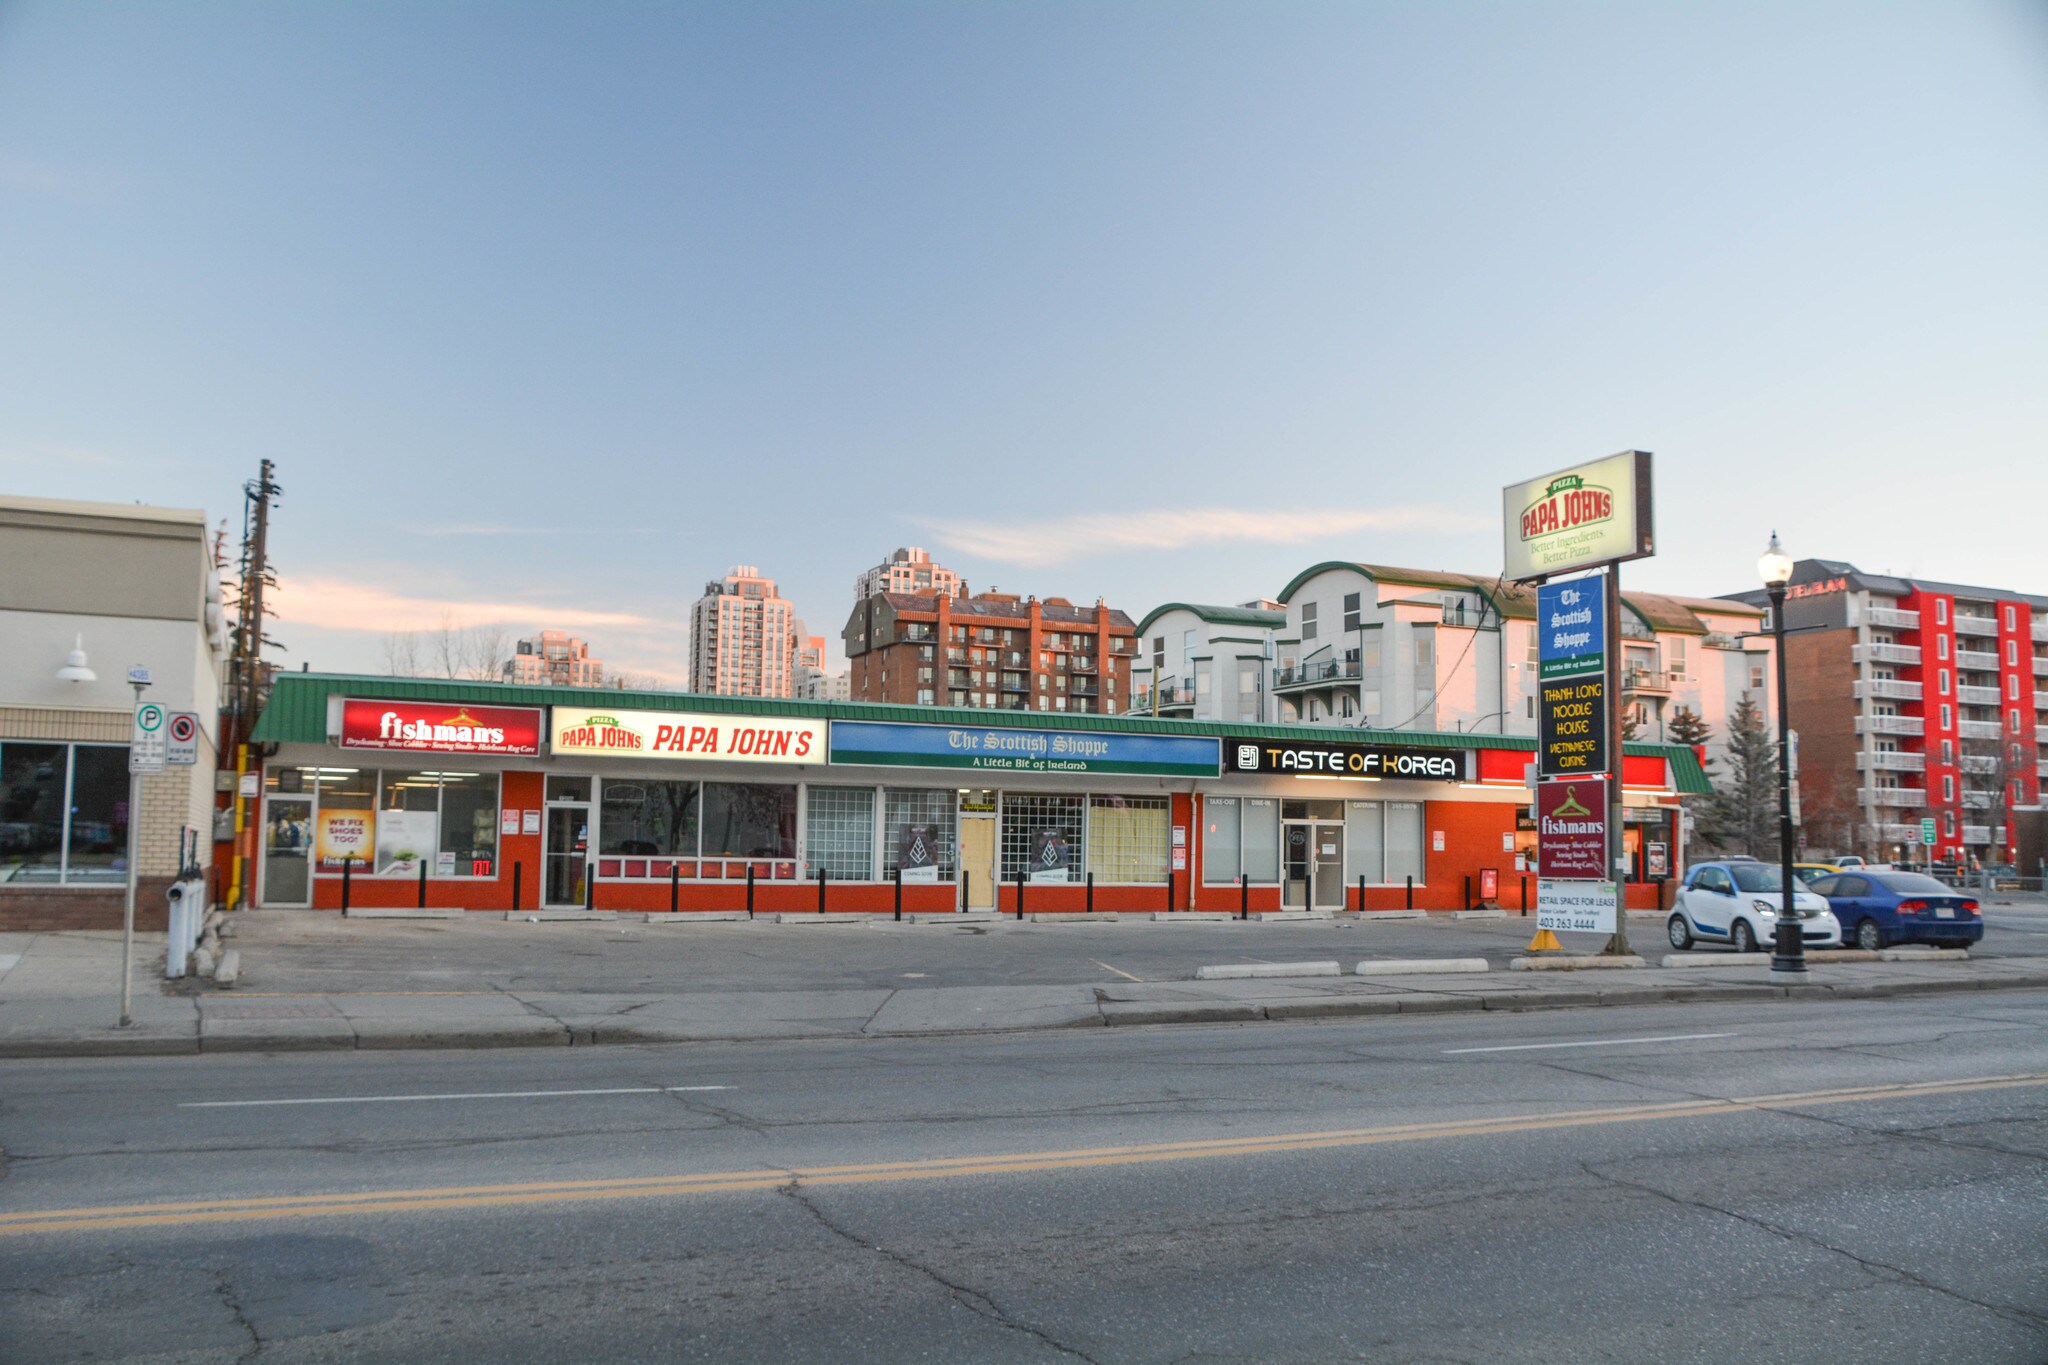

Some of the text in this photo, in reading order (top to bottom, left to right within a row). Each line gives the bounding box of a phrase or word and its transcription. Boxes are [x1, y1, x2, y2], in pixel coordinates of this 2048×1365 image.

[1552, 476, 1577, 490] PIZZA
[1522, 497, 1559, 537] PAPA
[1531, 539, 1555, 554] Better
[1543, 549, 1568, 564] Better
[1561, 589, 1581, 606] The
[1551, 607, 1592, 628] Scottish
[1553, 632, 1591, 649] Shoppe
[1544, 683, 1602, 702] THANH LONG
[1553, 702, 1592, 718] NOODLE
[591, 716, 615, 725] PIZZA
[1557, 720, 1589, 735] HOUSE
[562, 727, 597, 747] PAPA
[652, 724, 813, 757] PAPA JOHN'S
[947, 730, 1109, 757] The Scottish Shoppe
[1549, 740, 1596, 754] VIETNAMESE
[972, 757, 1087, 770] A Little Bit of Ireland
[1029, 752, 1036, 760] &
[1266, 749, 1344, 771] TASTE
[1349, 753, 1379, 772] OF
[1383, 754, 1456, 776] KOREA
[1559, 755, 1587, 767] CUISINE
[328, 818, 346, 826] WE
[328, 827, 363, 835] SHOES
[1539, 896, 1615, 907] RETAIL SPACE FOR LEASE
[1539, 917, 1595, 930] 403 263 4444
